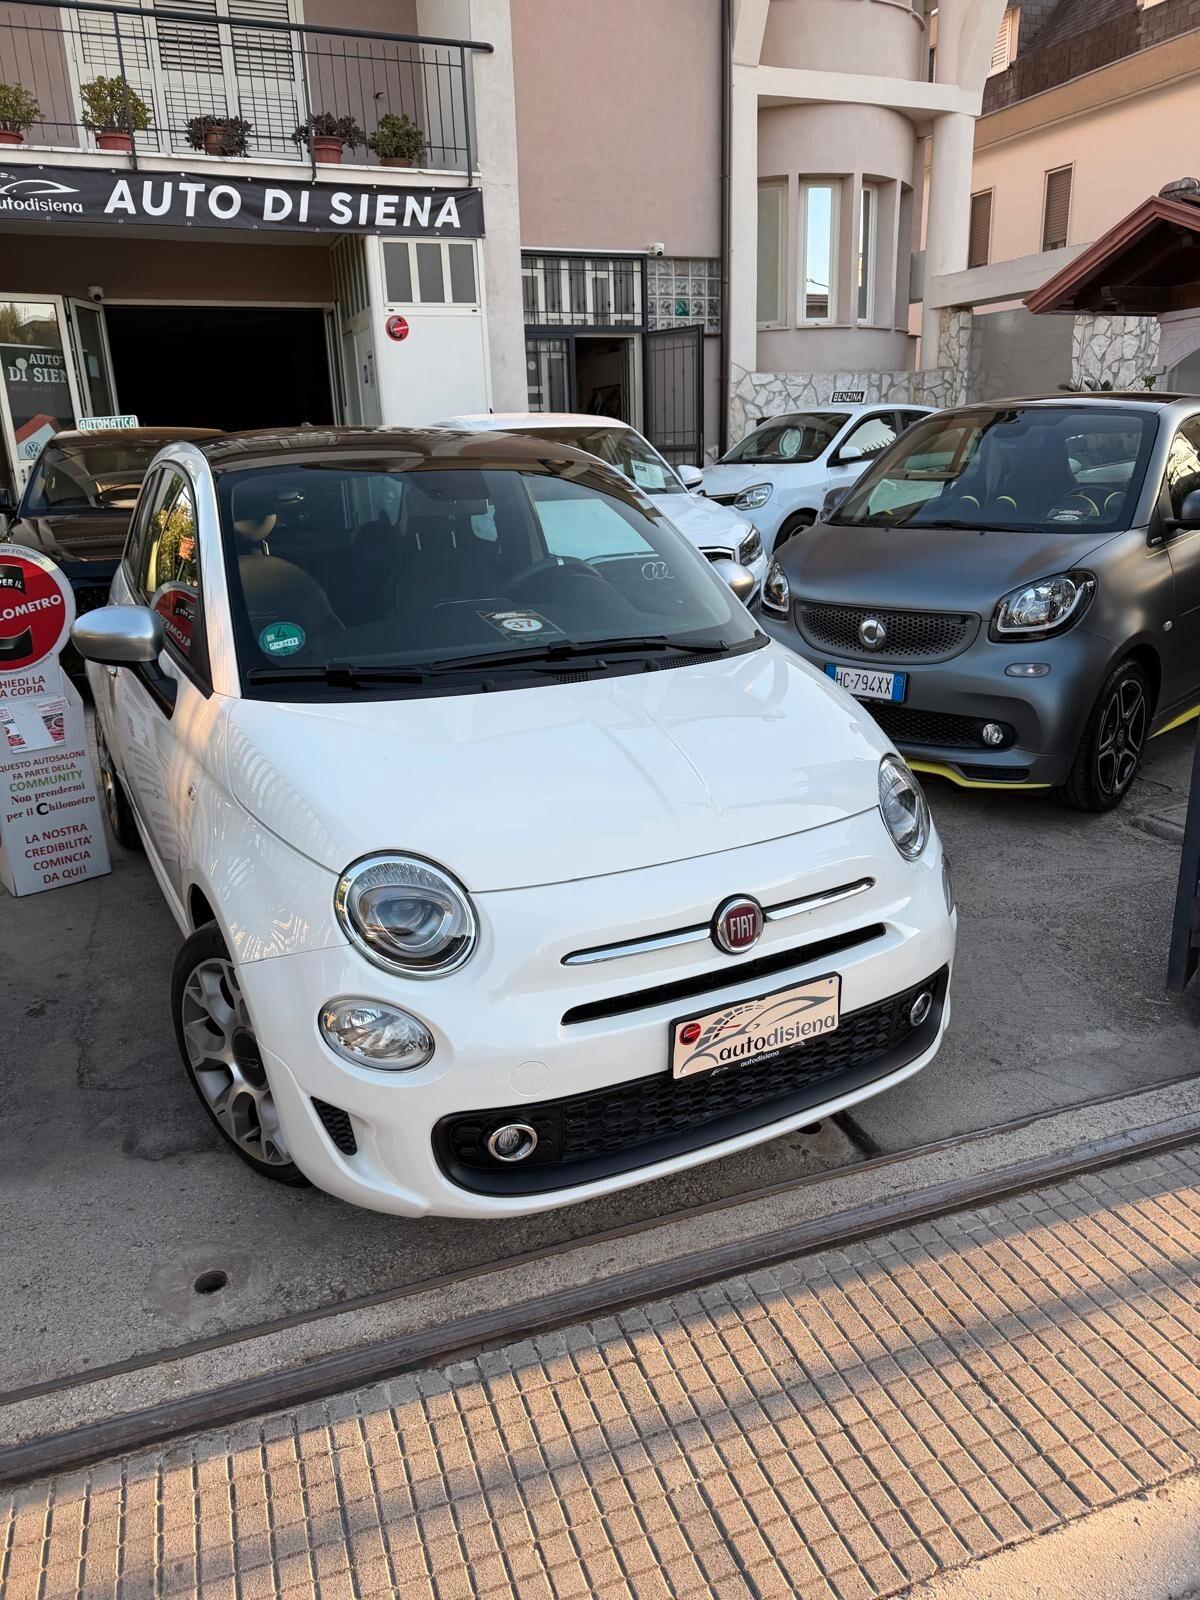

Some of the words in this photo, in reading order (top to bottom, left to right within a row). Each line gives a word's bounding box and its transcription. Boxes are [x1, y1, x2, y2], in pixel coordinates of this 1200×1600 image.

[104, 179, 242, 219] AUTO
[263, 188, 310, 223] DI
[328, 191, 461, 228] SIENA
[28, 353, 60, 365] AUTO
[833, 392, 862, 402] BENZINA
[79, 417, 135, 430] AUTOMATICA
[0, 578, 13, 586] ER
[32, 675, 45, 685] LA
[11, 685, 45, 696] COPIA
[0, 760, 31, 773] QUESTO
[32, 749, 86, 766] AUTOSALONE
[25, 767, 50, 778] PARTE
[52, 762, 76, 773] DELLA
[9, 770, 82, 792] COMMUNITY
[11, 793, 32, 805] Non
[34, 781, 86, 802] prendermi
[6, 811, 24, 823] per
[26, 807, 34, 816] il
[36, 795, 96, 816] Chilometro
[25, 833, 40, 844] LA
[42, 823, 88, 841] NOSTRA
[33, 850, 91, 871] COMINCIA
[43, 872, 60, 884] DA
[62, 864, 87, 879] QUI!
[729, 913, 755, 941] FIAT
[719, 1014, 835, 1061] autodisiena
[740, 1050, 780, 1067] autodisiena
